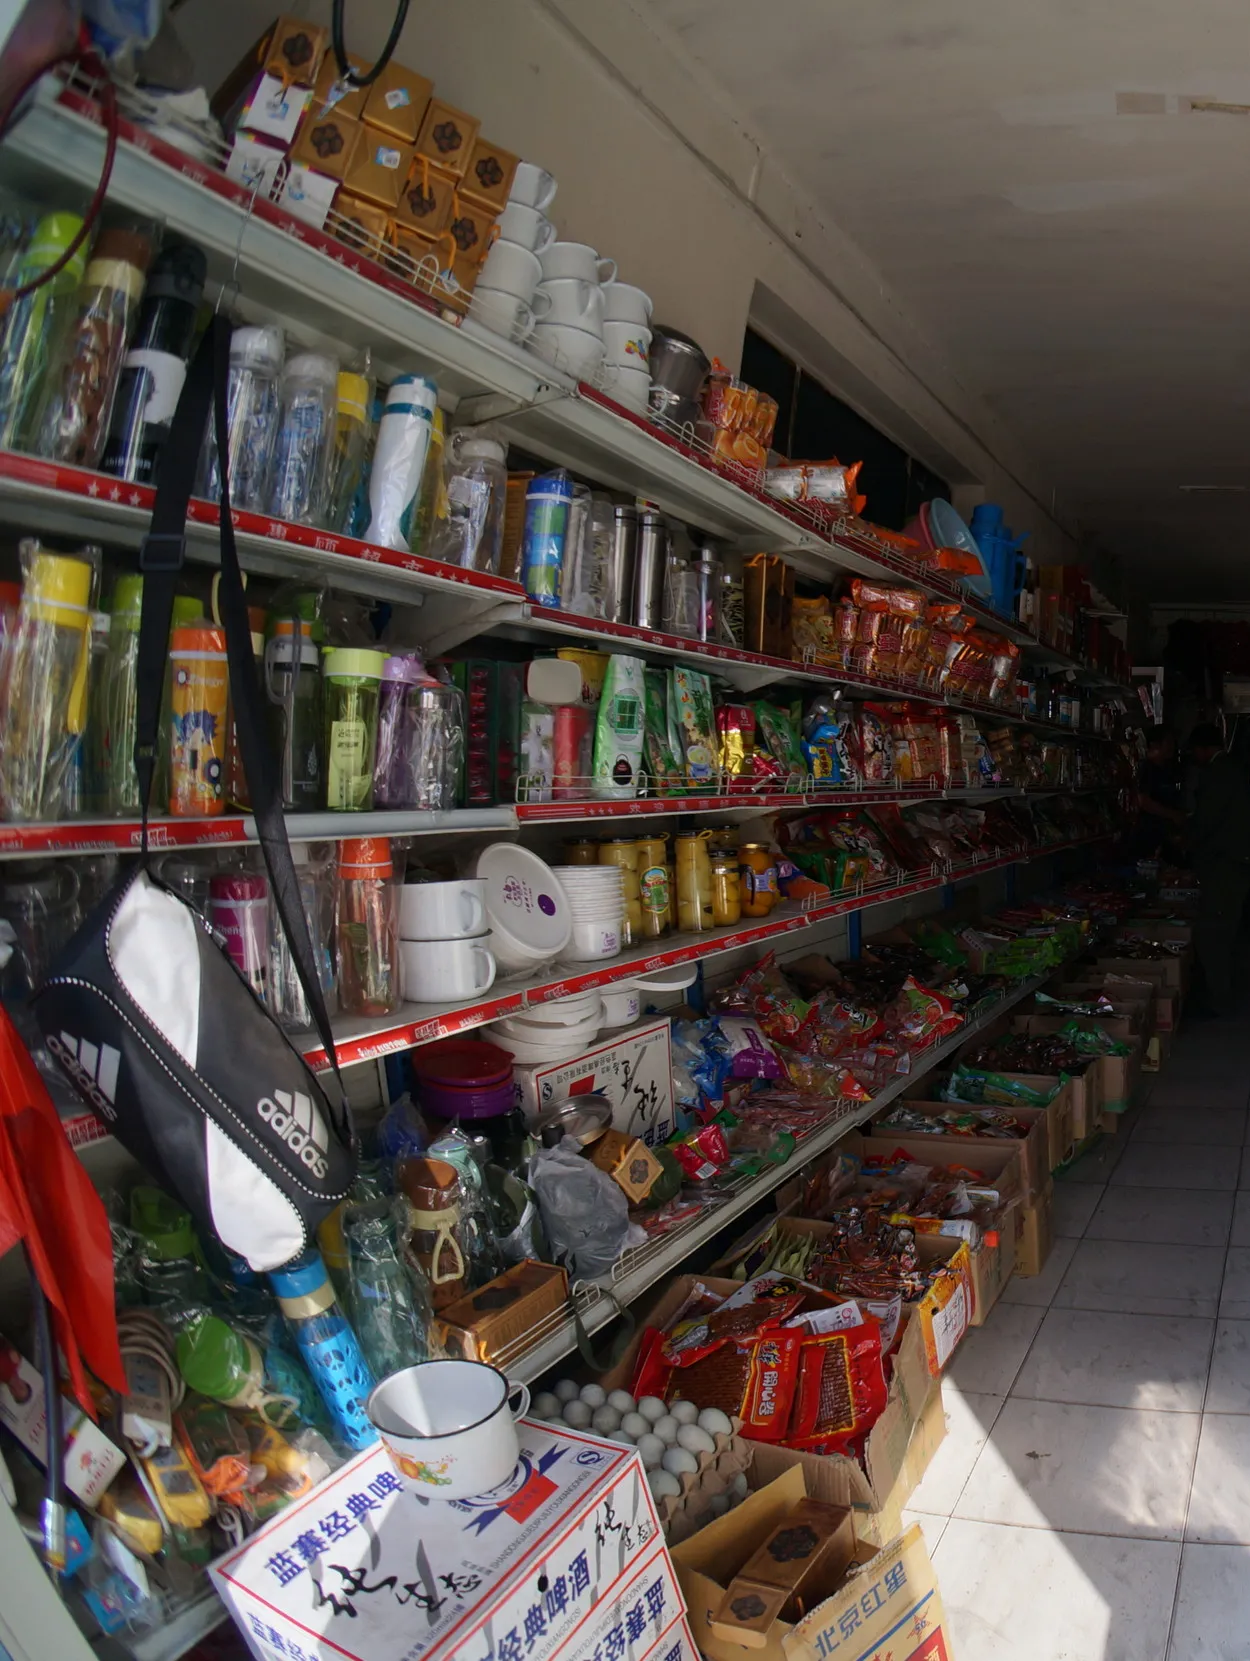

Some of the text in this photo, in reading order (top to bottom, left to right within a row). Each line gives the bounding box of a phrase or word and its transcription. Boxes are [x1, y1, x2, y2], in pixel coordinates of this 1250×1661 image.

[46, 1034, 118, 1122] adidas
[257, 1097, 329, 1180] adidas
[479, 1548, 591, 1661] 经典啤酒
[813, 1560, 908, 1661] 北京红星
